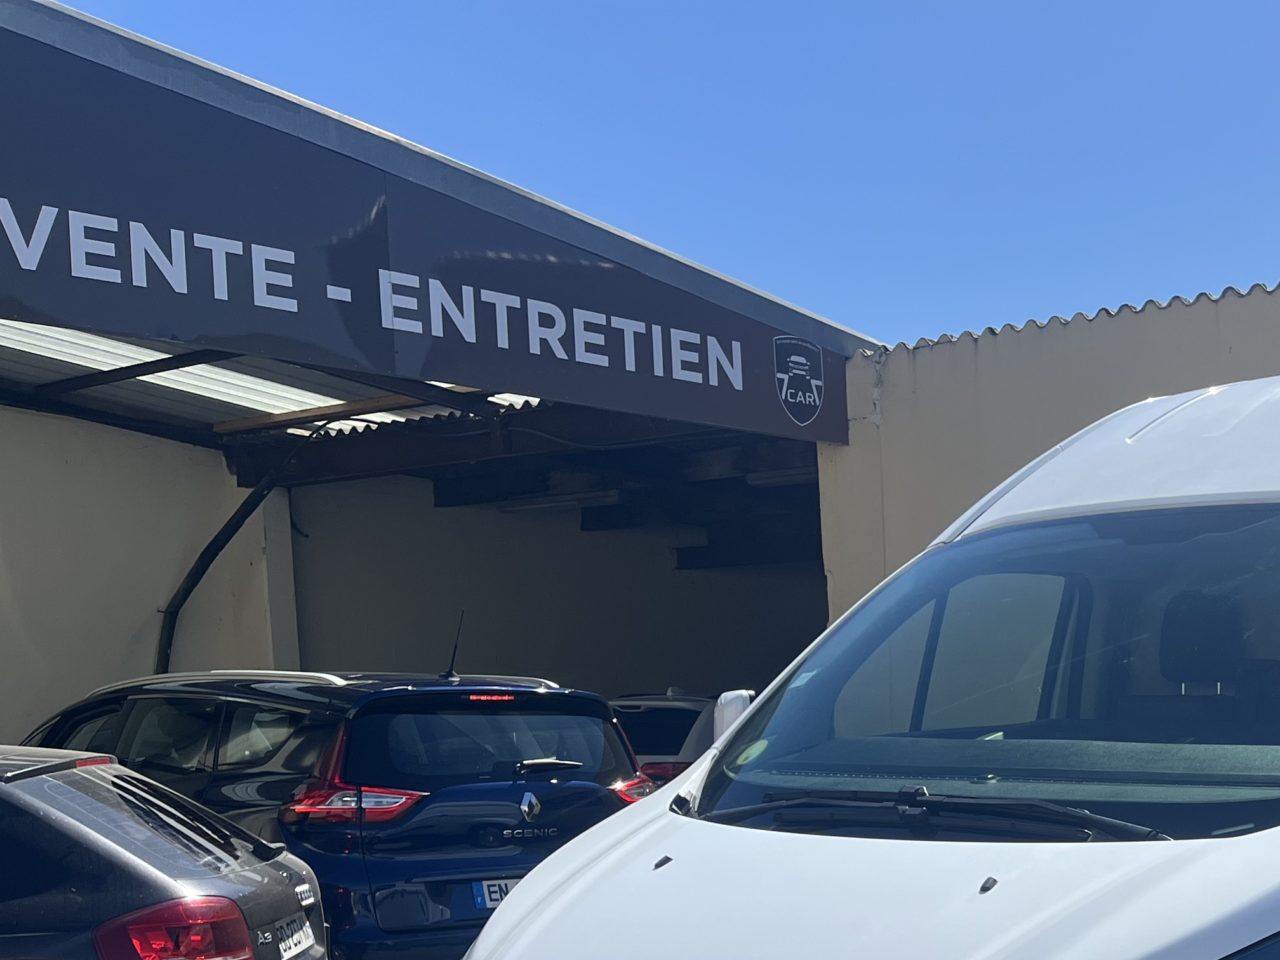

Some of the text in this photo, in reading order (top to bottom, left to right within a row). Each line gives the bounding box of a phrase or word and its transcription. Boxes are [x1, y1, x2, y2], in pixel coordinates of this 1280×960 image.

[0, 197, 298, 313] VENTE
[378, 268, 743, 391] ENTRETIEN
[503, 827, 558, 839] SCENIC
[257, 930, 272, 946] A3
